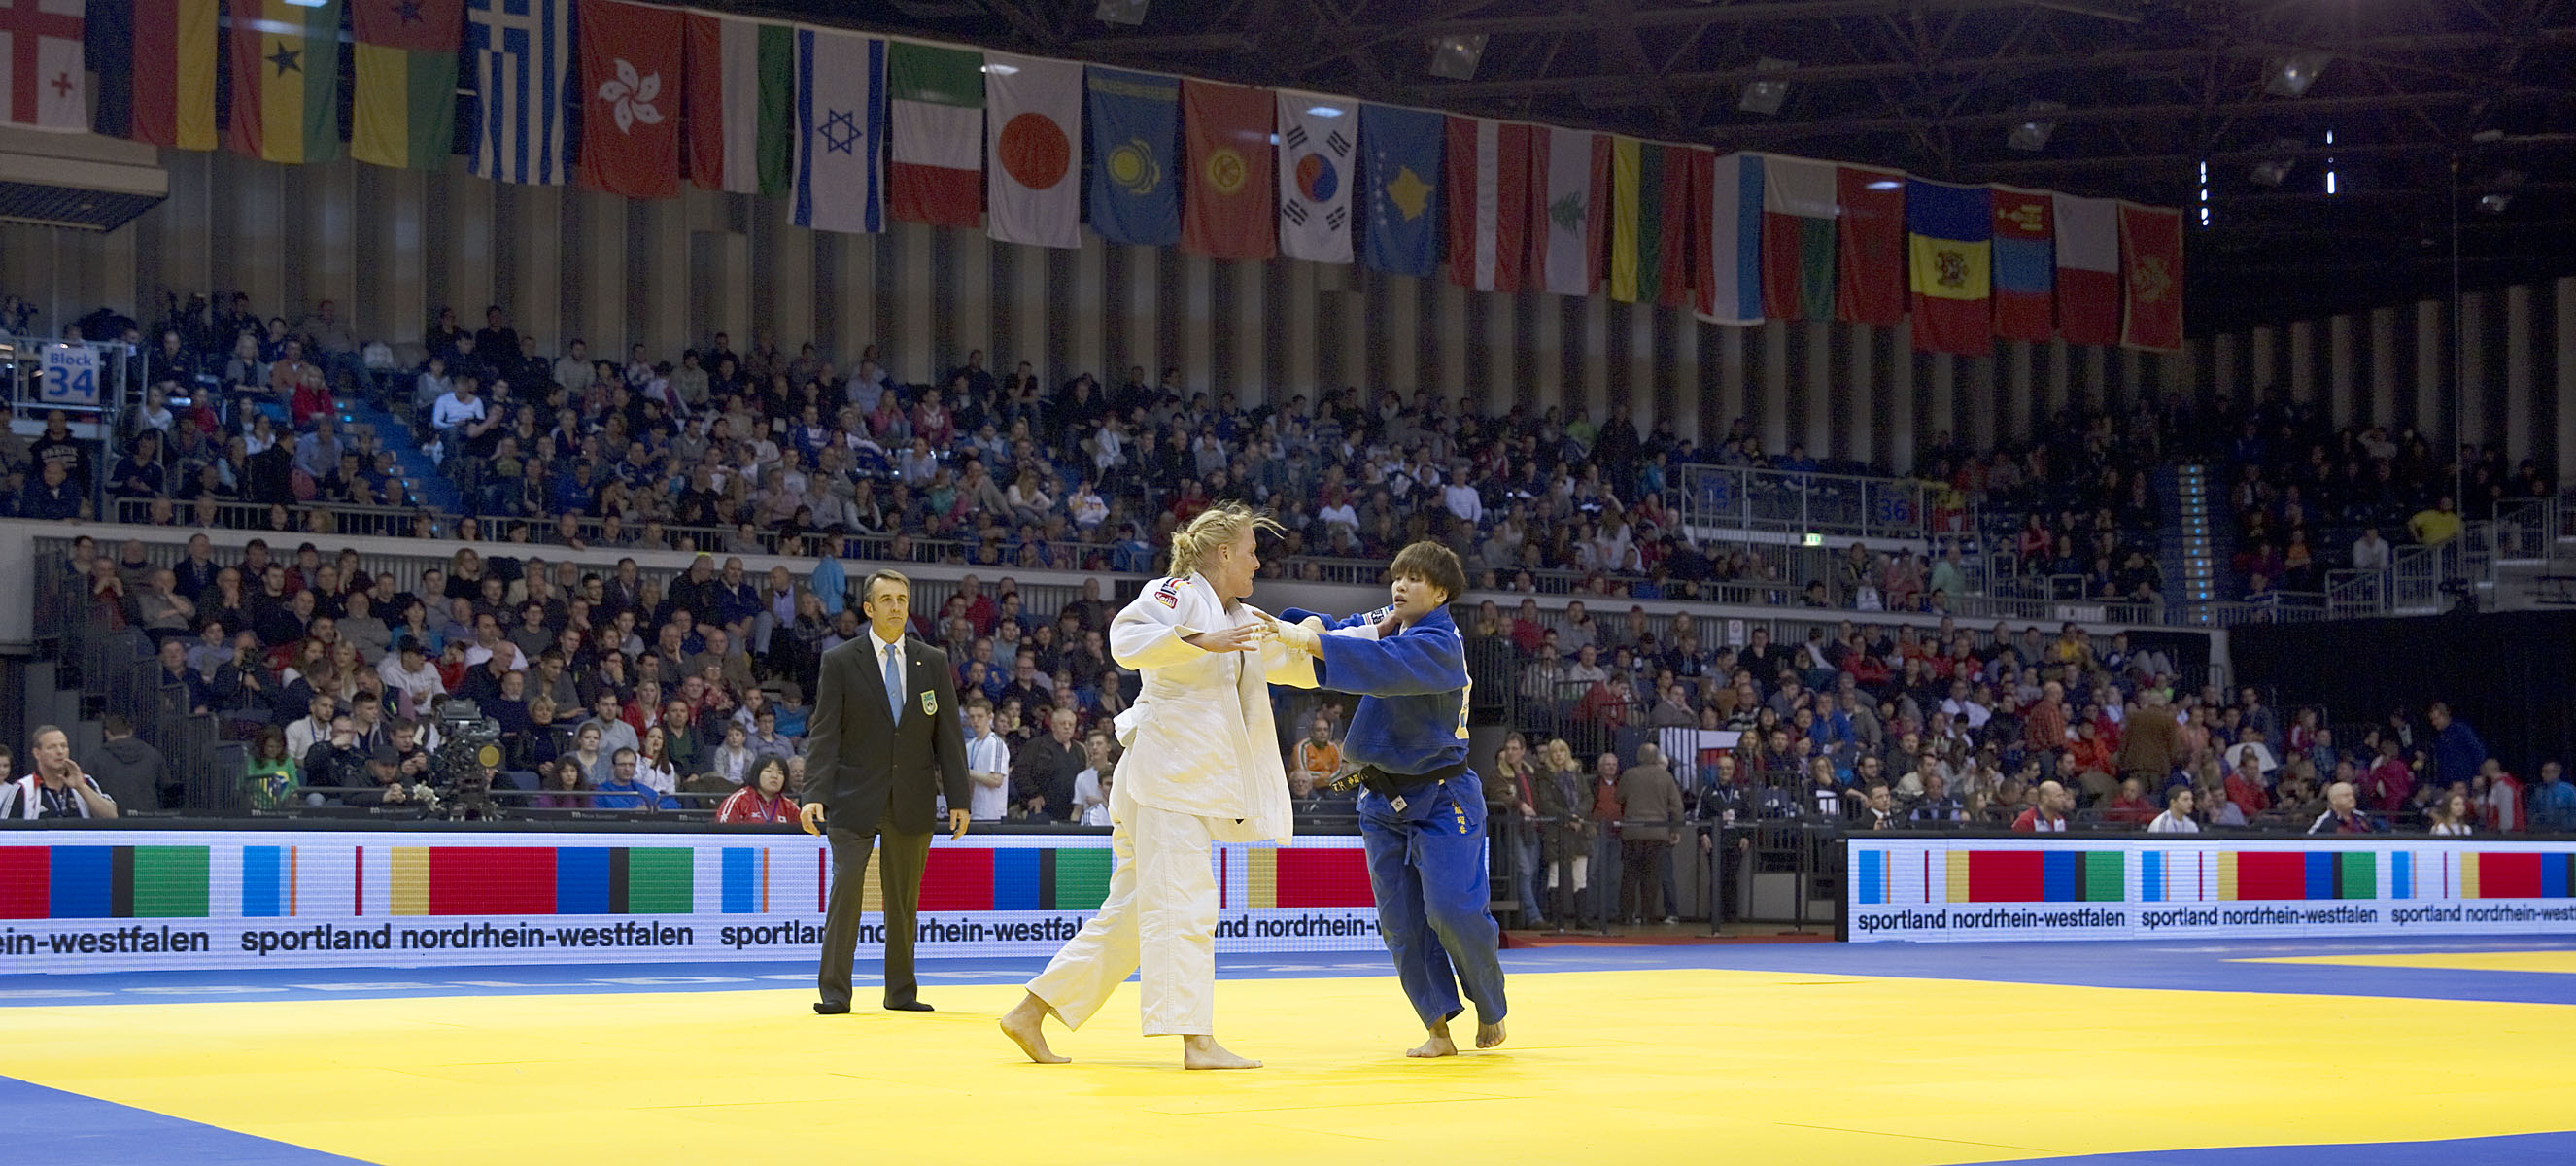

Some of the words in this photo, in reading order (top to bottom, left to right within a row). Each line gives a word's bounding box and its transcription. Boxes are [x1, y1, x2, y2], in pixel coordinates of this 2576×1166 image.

[51, 353, 93, 365] Block
[49, 366, 95, 396] 34
[1879, 497, 1907, 522] 36
[1858, 909, 1946, 934] sportland
[1952, 907, 2125, 929] nordrhein-westfalen
[2142, 906, 2217, 929] sportland
[2223, 905, 2377, 925] nordrhein-westfalen
[2391, 904, 2461, 925] sportland
[241, 923, 391, 956] sportland
[401, 921, 693, 951] nordrhein-westfalen
[720, 919, 825, 950] sportla
